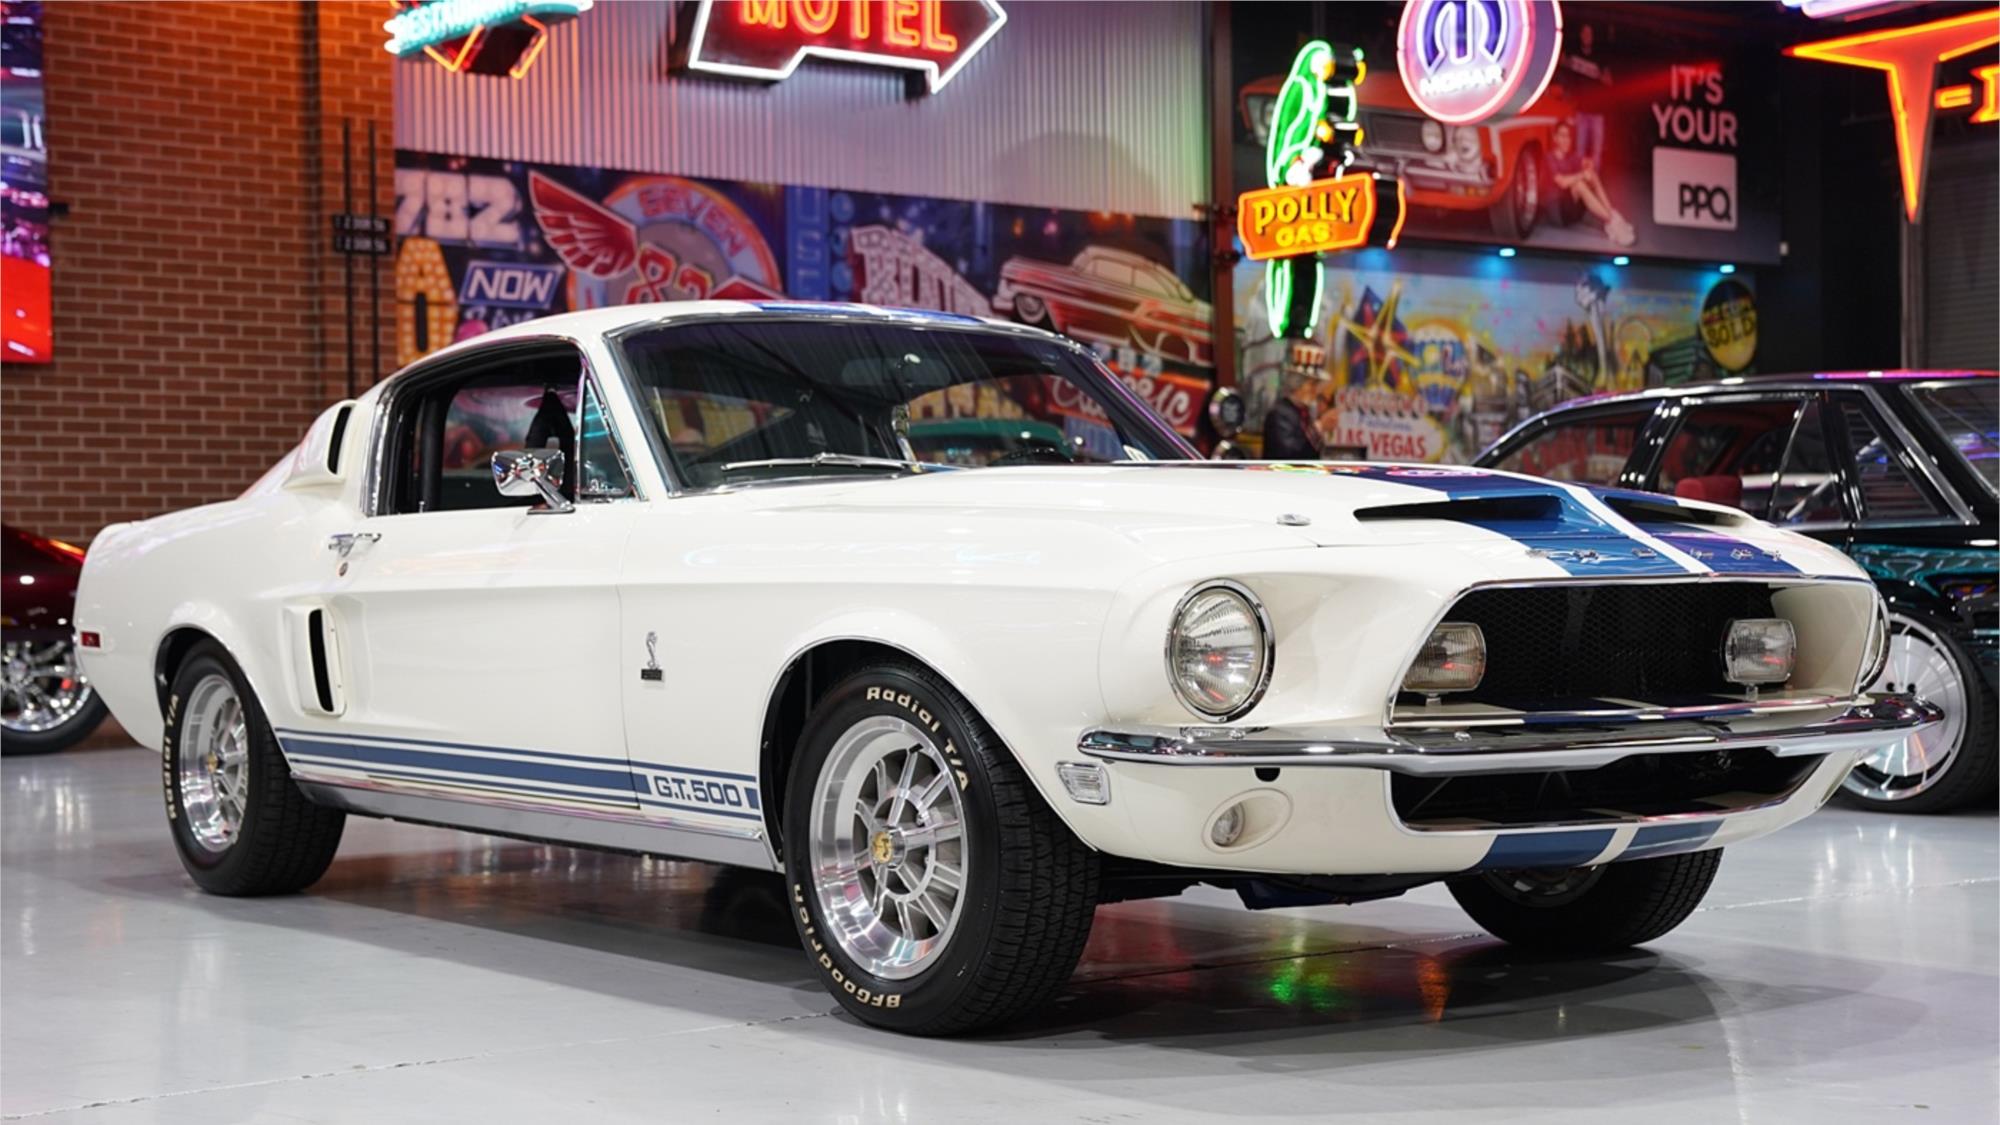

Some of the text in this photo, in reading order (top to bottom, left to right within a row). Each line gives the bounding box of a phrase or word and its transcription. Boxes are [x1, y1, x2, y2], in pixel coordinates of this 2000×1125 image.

[739, 0, 957, 52] MOTEL
[1420, 64, 1504, 97] MOPAR
[1671, 65, 1724, 105] IT'S
[1652, 103, 1738, 147] YOUR
[395, 168, 520, 243] 782
[1252, 187, 1357, 235] POLLY
[1679, 182, 1732, 223] PPQ
[1275, 222, 1331, 248] GAS
[467, 269, 554, 303] NOW
[1368, 431, 1427, 460] VEGAS
[866, 686, 969, 792] Radial T/A
[653, 775, 743, 807] G.T.500
